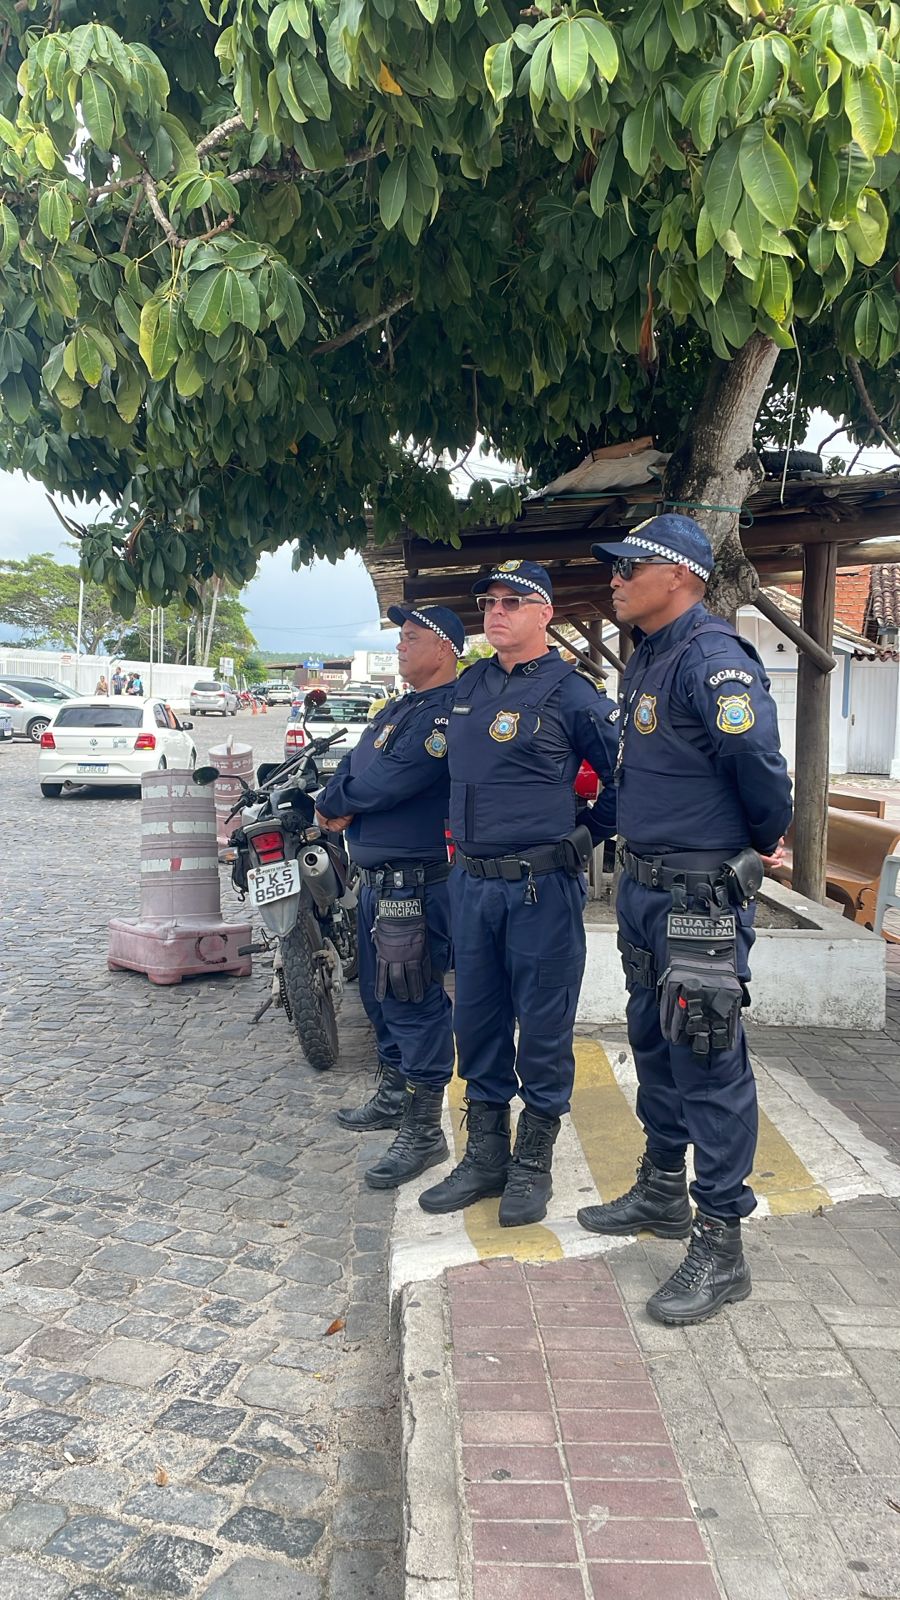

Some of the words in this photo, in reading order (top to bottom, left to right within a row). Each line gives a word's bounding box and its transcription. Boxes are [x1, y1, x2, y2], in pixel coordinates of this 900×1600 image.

[709, 669, 753, 686] GCM-PS
[255, 869, 292, 889] PKS
[255, 880, 294, 903] 8567
[380, 900, 419, 908] GUARDA
[380, 907, 420, 916] MUNICIPAL
[672, 926, 733, 935] MUNICIPAL
